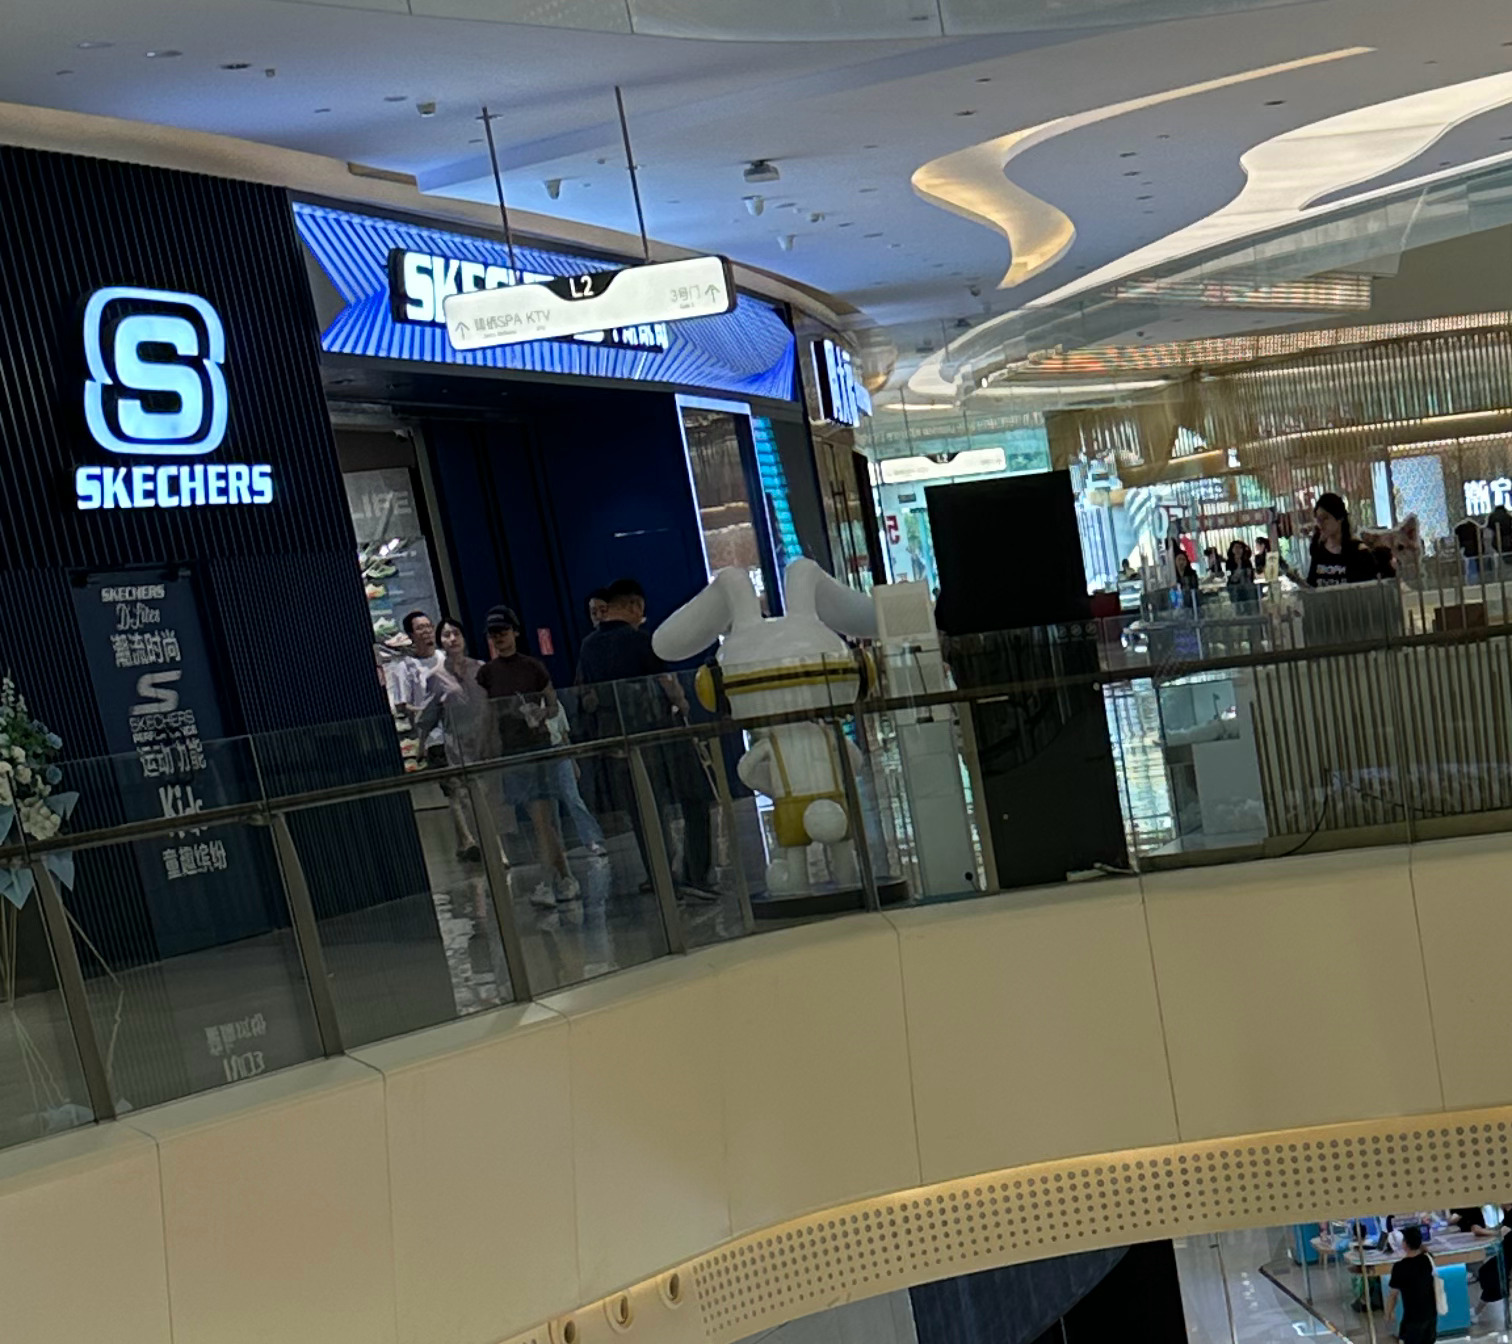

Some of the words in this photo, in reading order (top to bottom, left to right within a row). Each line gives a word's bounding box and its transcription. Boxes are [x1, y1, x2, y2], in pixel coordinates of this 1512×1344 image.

[569, 275, 593, 299] L2
[526, 310, 550, 324] KTV
[76, 464, 273, 509] SKECHERS
[101, 584, 166, 603] SKECHERS
